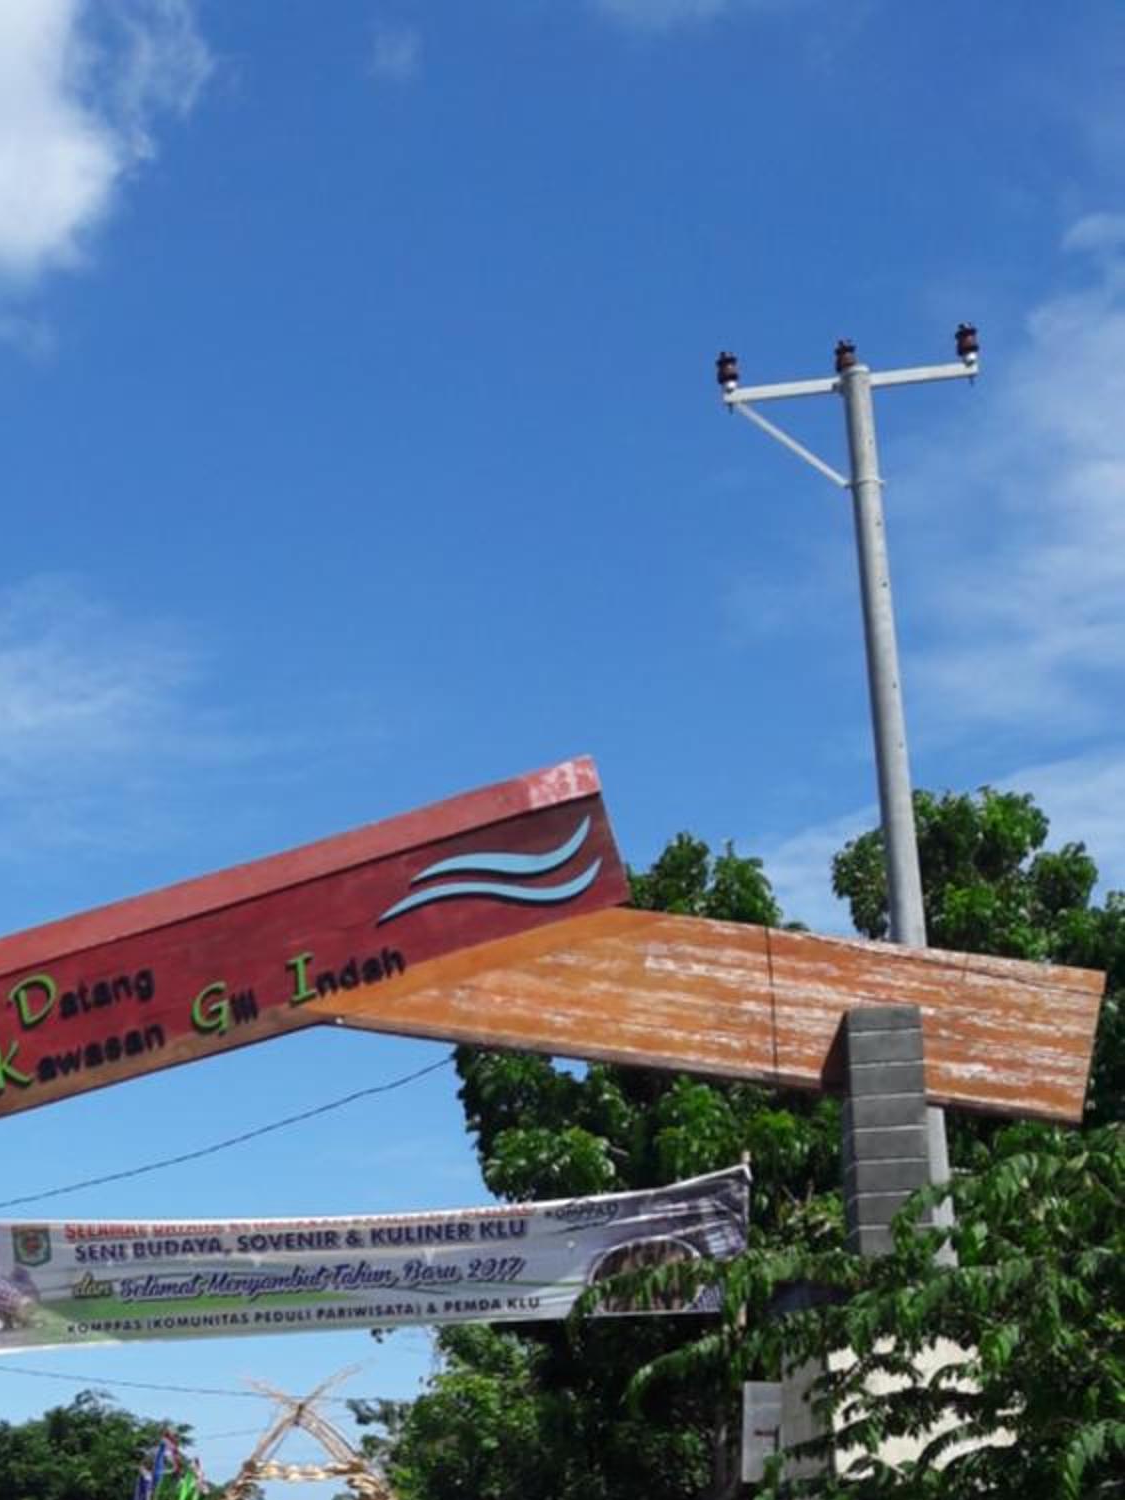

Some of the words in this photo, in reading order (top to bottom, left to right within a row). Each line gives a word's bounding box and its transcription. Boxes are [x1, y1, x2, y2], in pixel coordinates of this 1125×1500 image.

[8, 968, 155, 1031] Datang
[190, 979, 259, 1038] Gili
[286, 946, 406, 1009] Indah
[75, 1242, 125, 1264] SENI
[237, 1230, 340, 1252] SOVENIR
[346, 1227, 365, 1248] &
[370, 1220, 474, 1246] KULINER
[479, 1218, 528, 1240] KLU
[119, 1273, 203, 1303] Selamat
[206, 1264, 327, 1302] Menyambut
[465, 1255, 527, 1281] 2017
[254, 1308, 312, 1324] PEDULI
[427, 1299, 439, 1314] &
[444, 1298, 503, 1314] PEMDA
[507, 1296, 541, 1310] KLU
